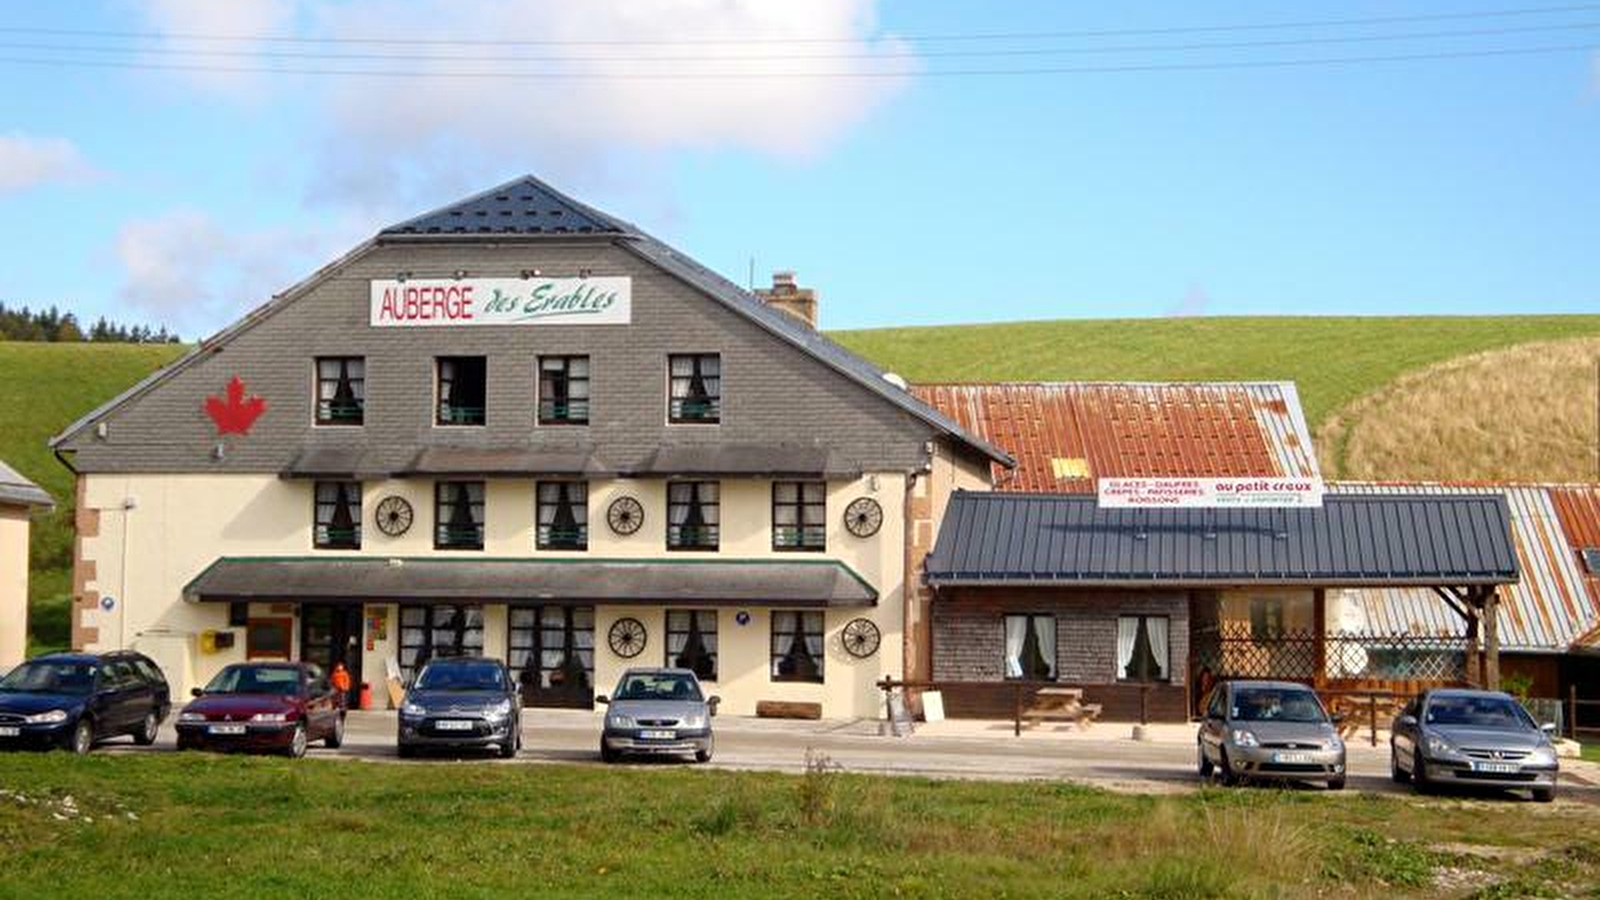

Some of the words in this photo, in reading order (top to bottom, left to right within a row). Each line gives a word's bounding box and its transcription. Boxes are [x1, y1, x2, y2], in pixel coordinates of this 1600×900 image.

[380, 287, 473, 319] AUBERGE
[484, 289, 519, 313] des
[523, 283, 618, 313] Erables
[1215, 483, 1233, 491] au
[1235, 481, 1269, 494] petit
[1272, 482, 1312, 491] creux
